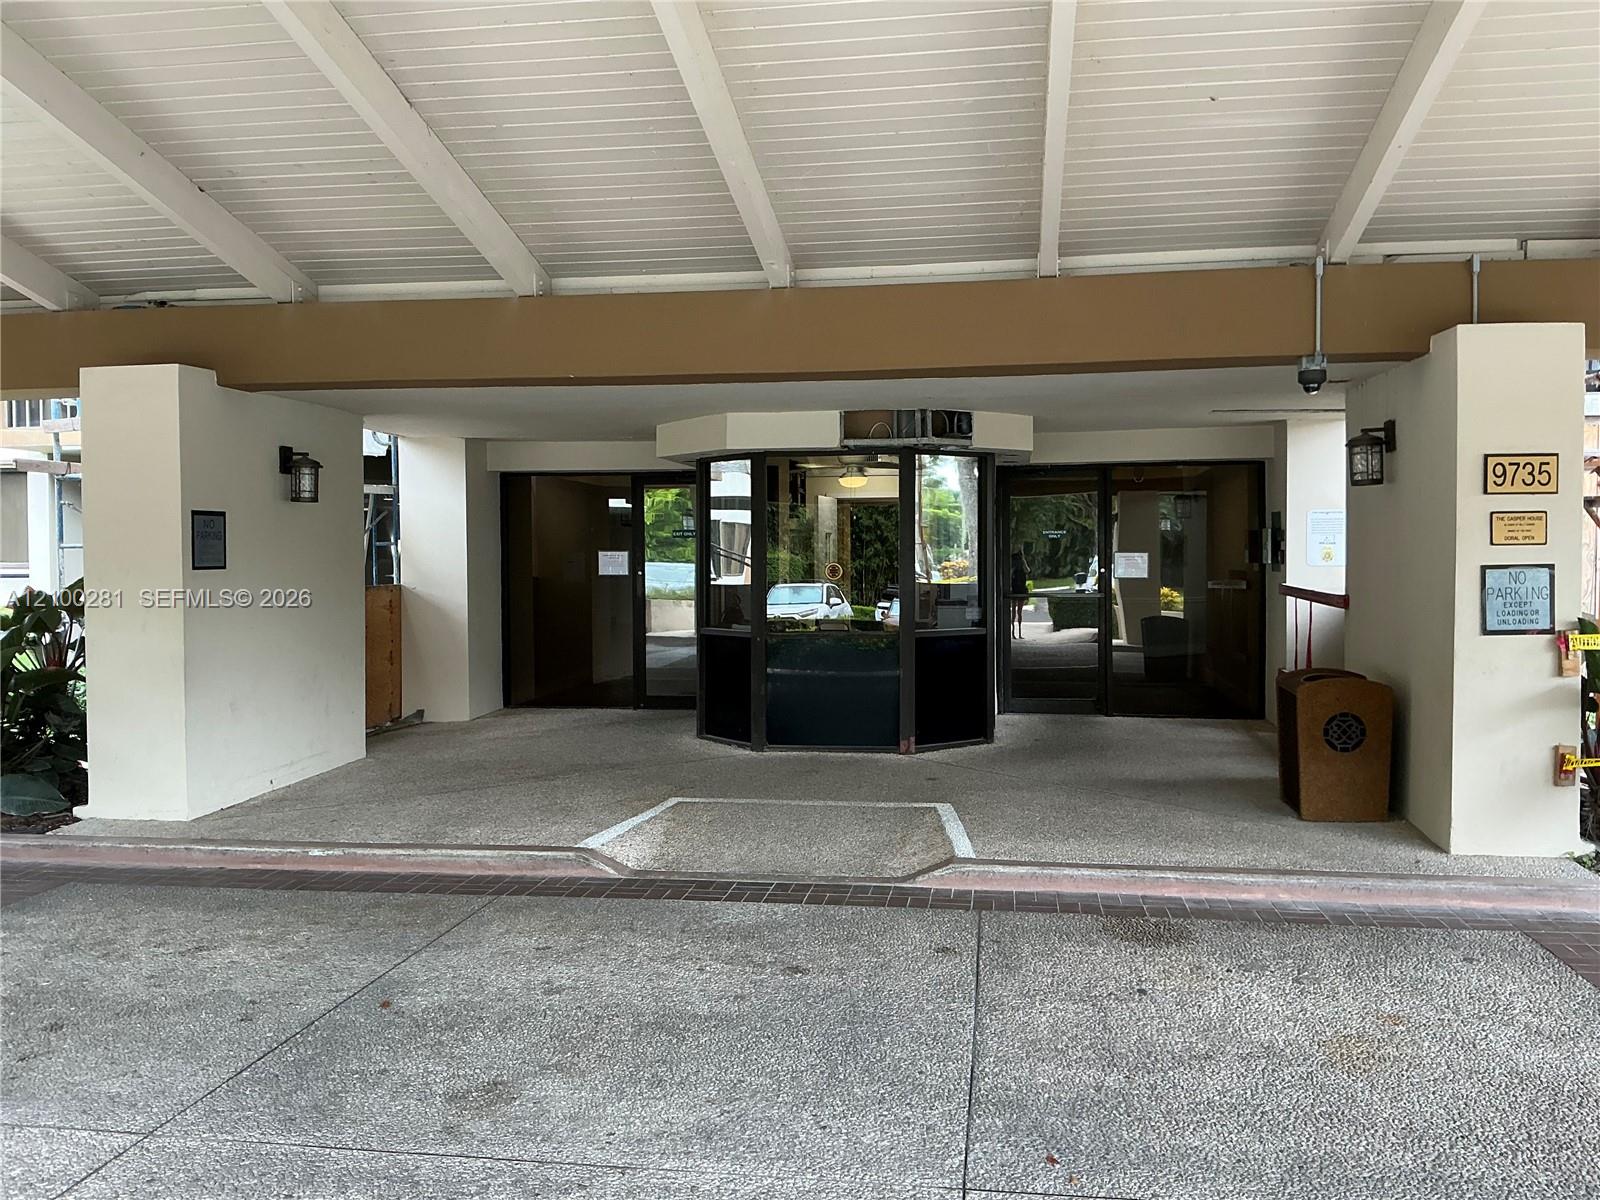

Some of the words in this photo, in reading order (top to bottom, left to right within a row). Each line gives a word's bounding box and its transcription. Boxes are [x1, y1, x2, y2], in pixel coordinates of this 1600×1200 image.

[1492, 461, 1552, 487] 9735
[203, 519, 215, 529] NO
[1508, 570, 1527, 585] NO
[1486, 586, 1549, 601] PARKING
[1503, 601, 1533, 609] EXCEPT
[1496, 610, 1529, 618] LOADING
[1496, 618, 1540, 626] UNLOADING
